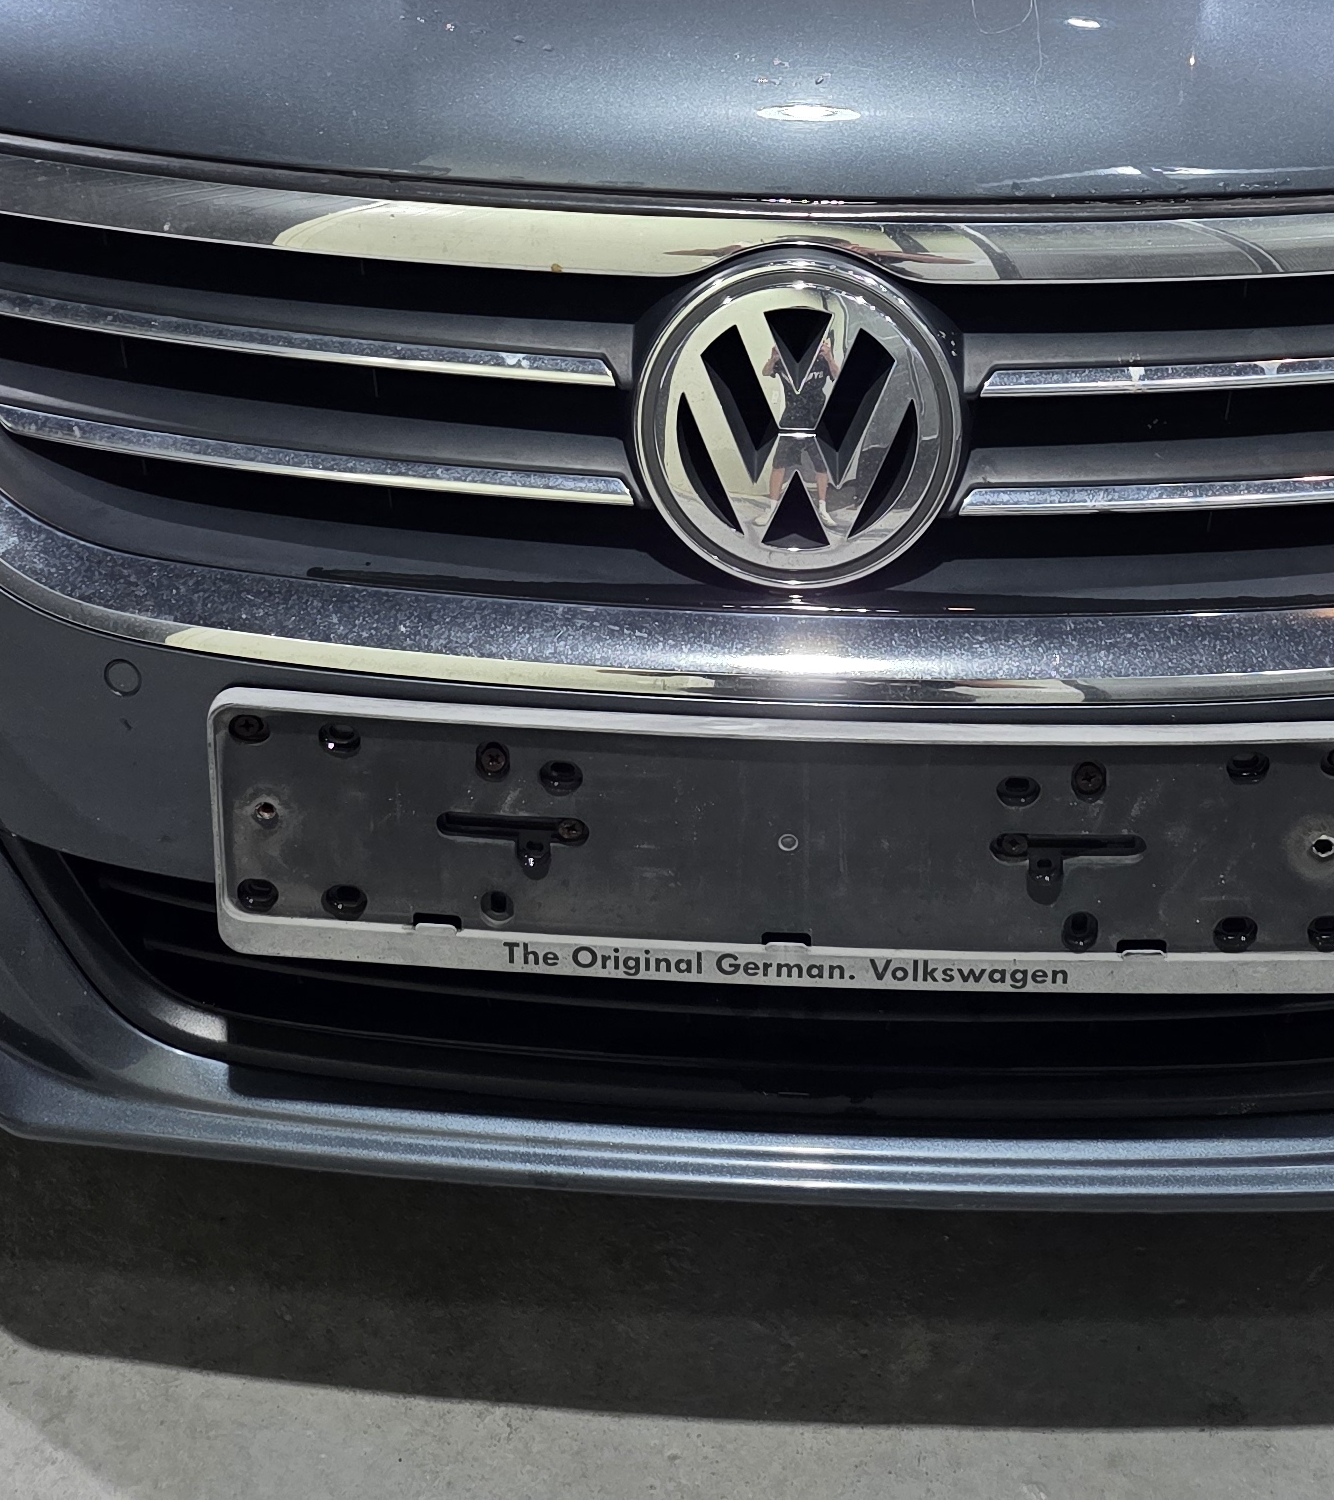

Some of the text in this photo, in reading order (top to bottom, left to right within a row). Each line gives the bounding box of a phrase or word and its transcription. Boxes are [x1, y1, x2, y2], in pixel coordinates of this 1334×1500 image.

[657, 283, 942, 573] VW
[502, 941, 1069, 990] The Original German. Volkswagen
